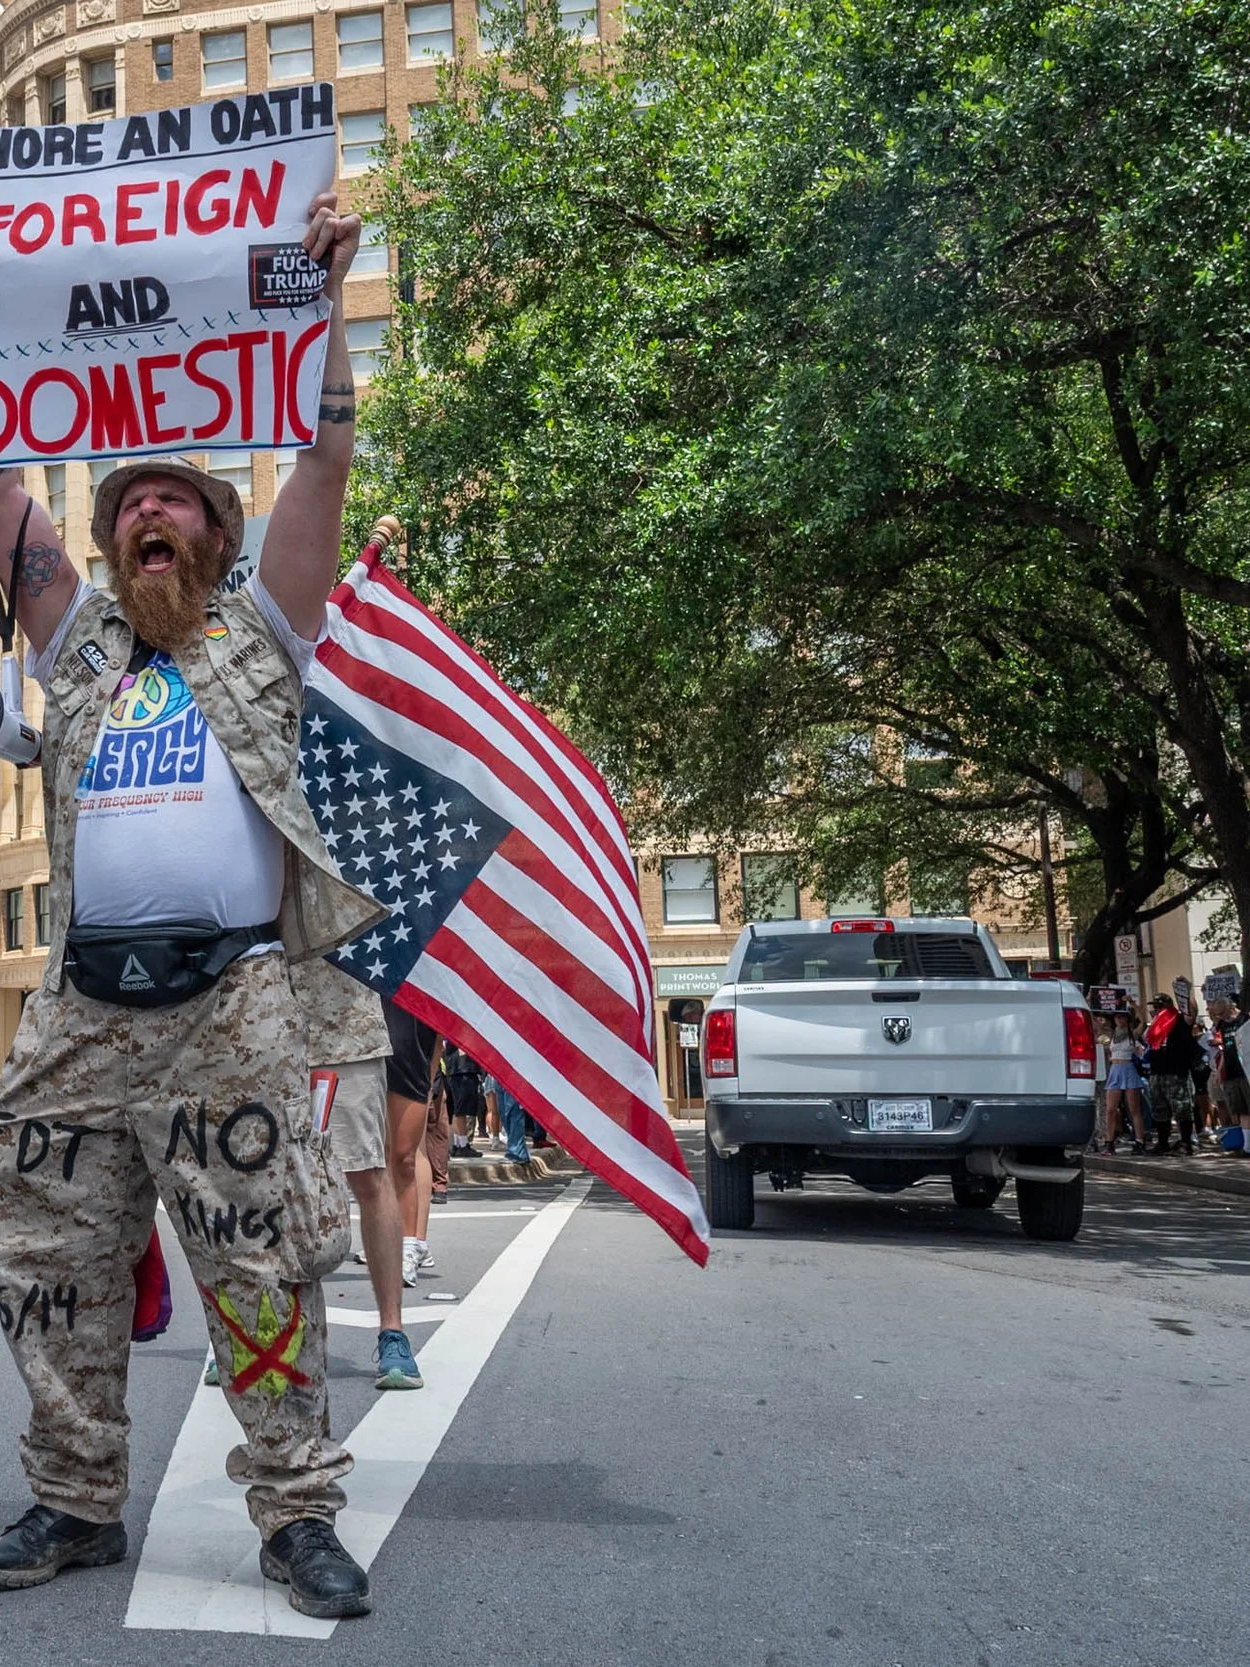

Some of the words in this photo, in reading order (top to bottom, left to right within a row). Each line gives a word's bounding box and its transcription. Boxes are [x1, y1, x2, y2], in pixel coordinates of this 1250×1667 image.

[117, 108, 192, 161] AN
[210, 83, 333, 145] OATH
[272, 255, 320, 272] FUCK
[263, 269, 327, 290] TRUMP
[64, 276, 171, 331] AND
[85, 645, 107, 668] 420
[229, 638, 267, 669] MARINES
[64, 653, 96, 687] NELSON
[91, 706, 208, 792] ERGY
[78, 799, 94, 811] OUR
[98, 792, 169, 809] FREQUENCY
[172, 790, 203, 802] HIGH
[119, 980, 156, 992] Reebok
[672, 972, 718, 982] THOMAS
[164, 1098, 280, 1171] NO
[174, 1188, 285, 1250] KINGS
